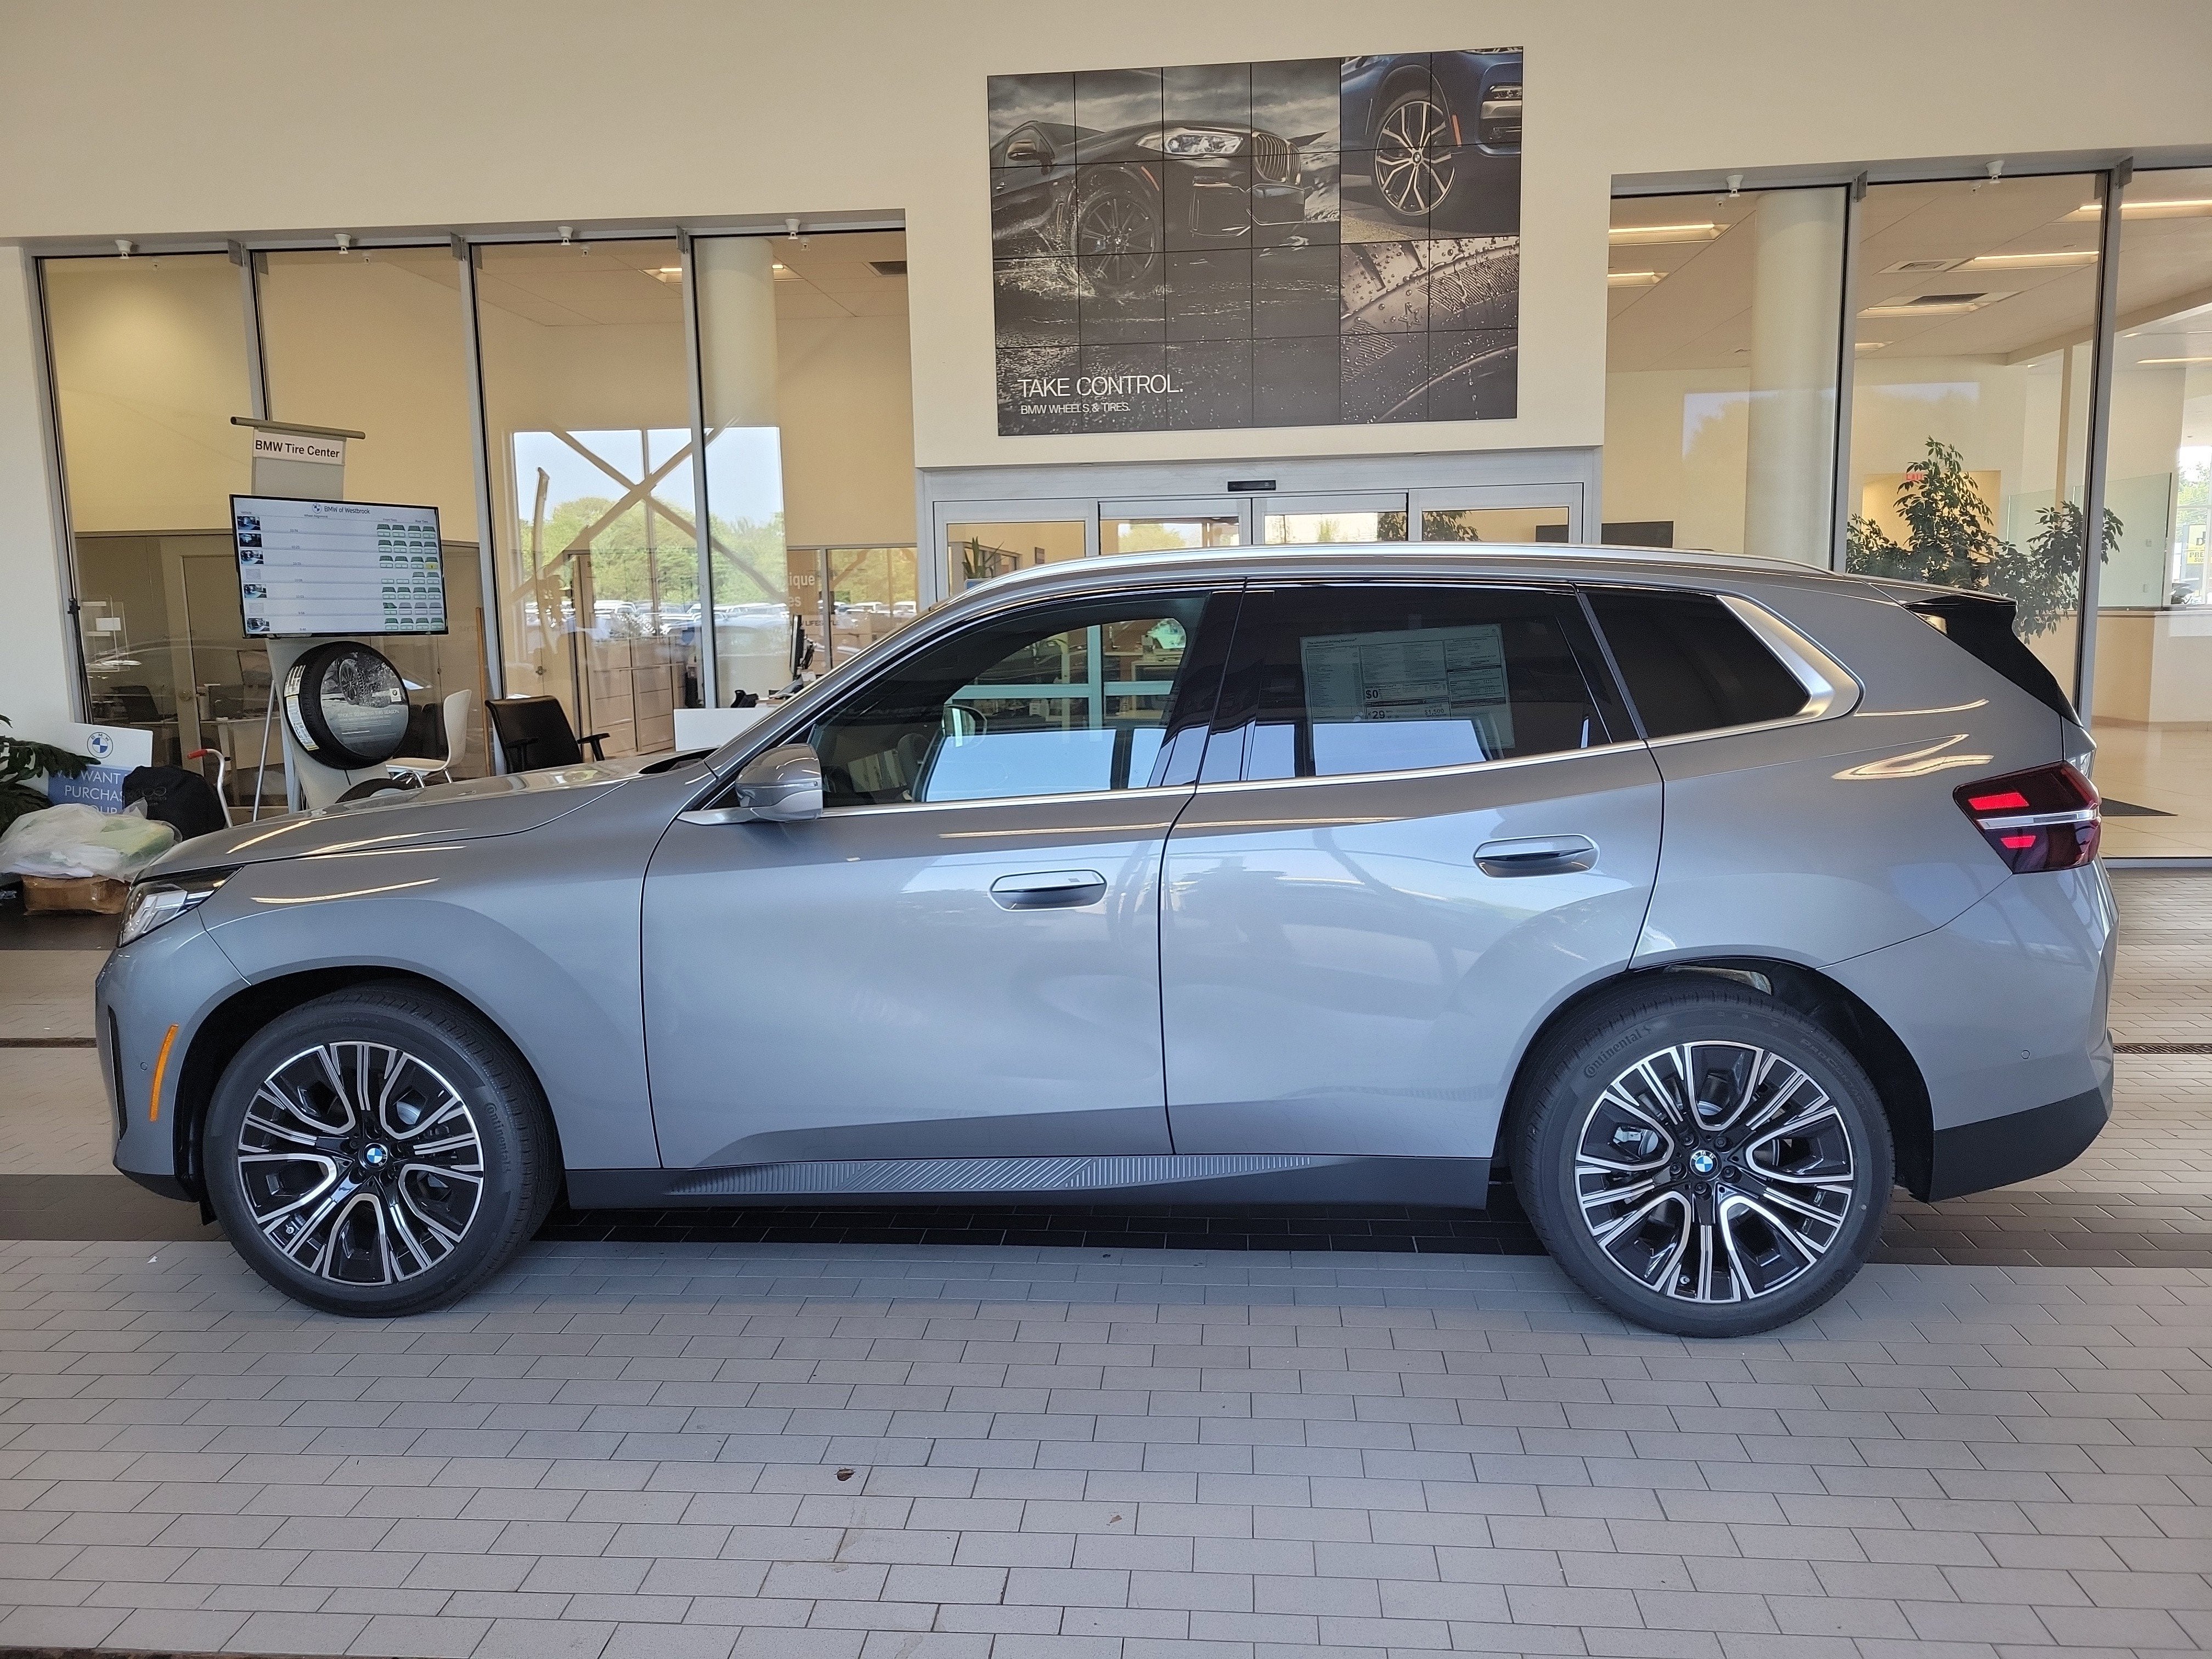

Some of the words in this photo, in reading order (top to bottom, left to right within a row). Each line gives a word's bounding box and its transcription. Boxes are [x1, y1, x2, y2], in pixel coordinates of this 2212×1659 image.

[1017, 377, 1070, 398] TAKE
[1076, 374, 1183, 397] CONTROL.
[1020, 404, 1047, 415] BMW
[1048, 403, 1090, 414] WHEELS
[1092, 403, 1099, 413] &
[1101, 402, 1131, 413] TIRES.
[255, 440, 283, 452] BMW
[285, 443, 304, 455] Tire
[307, 445, 340, 458] Center
[1365, 690, 1379, 699] $0
[1372, 710, 1385, 719] 29
[81, 770, 121, 785] WANT
[65, 785, 122, 802] PURCHA
